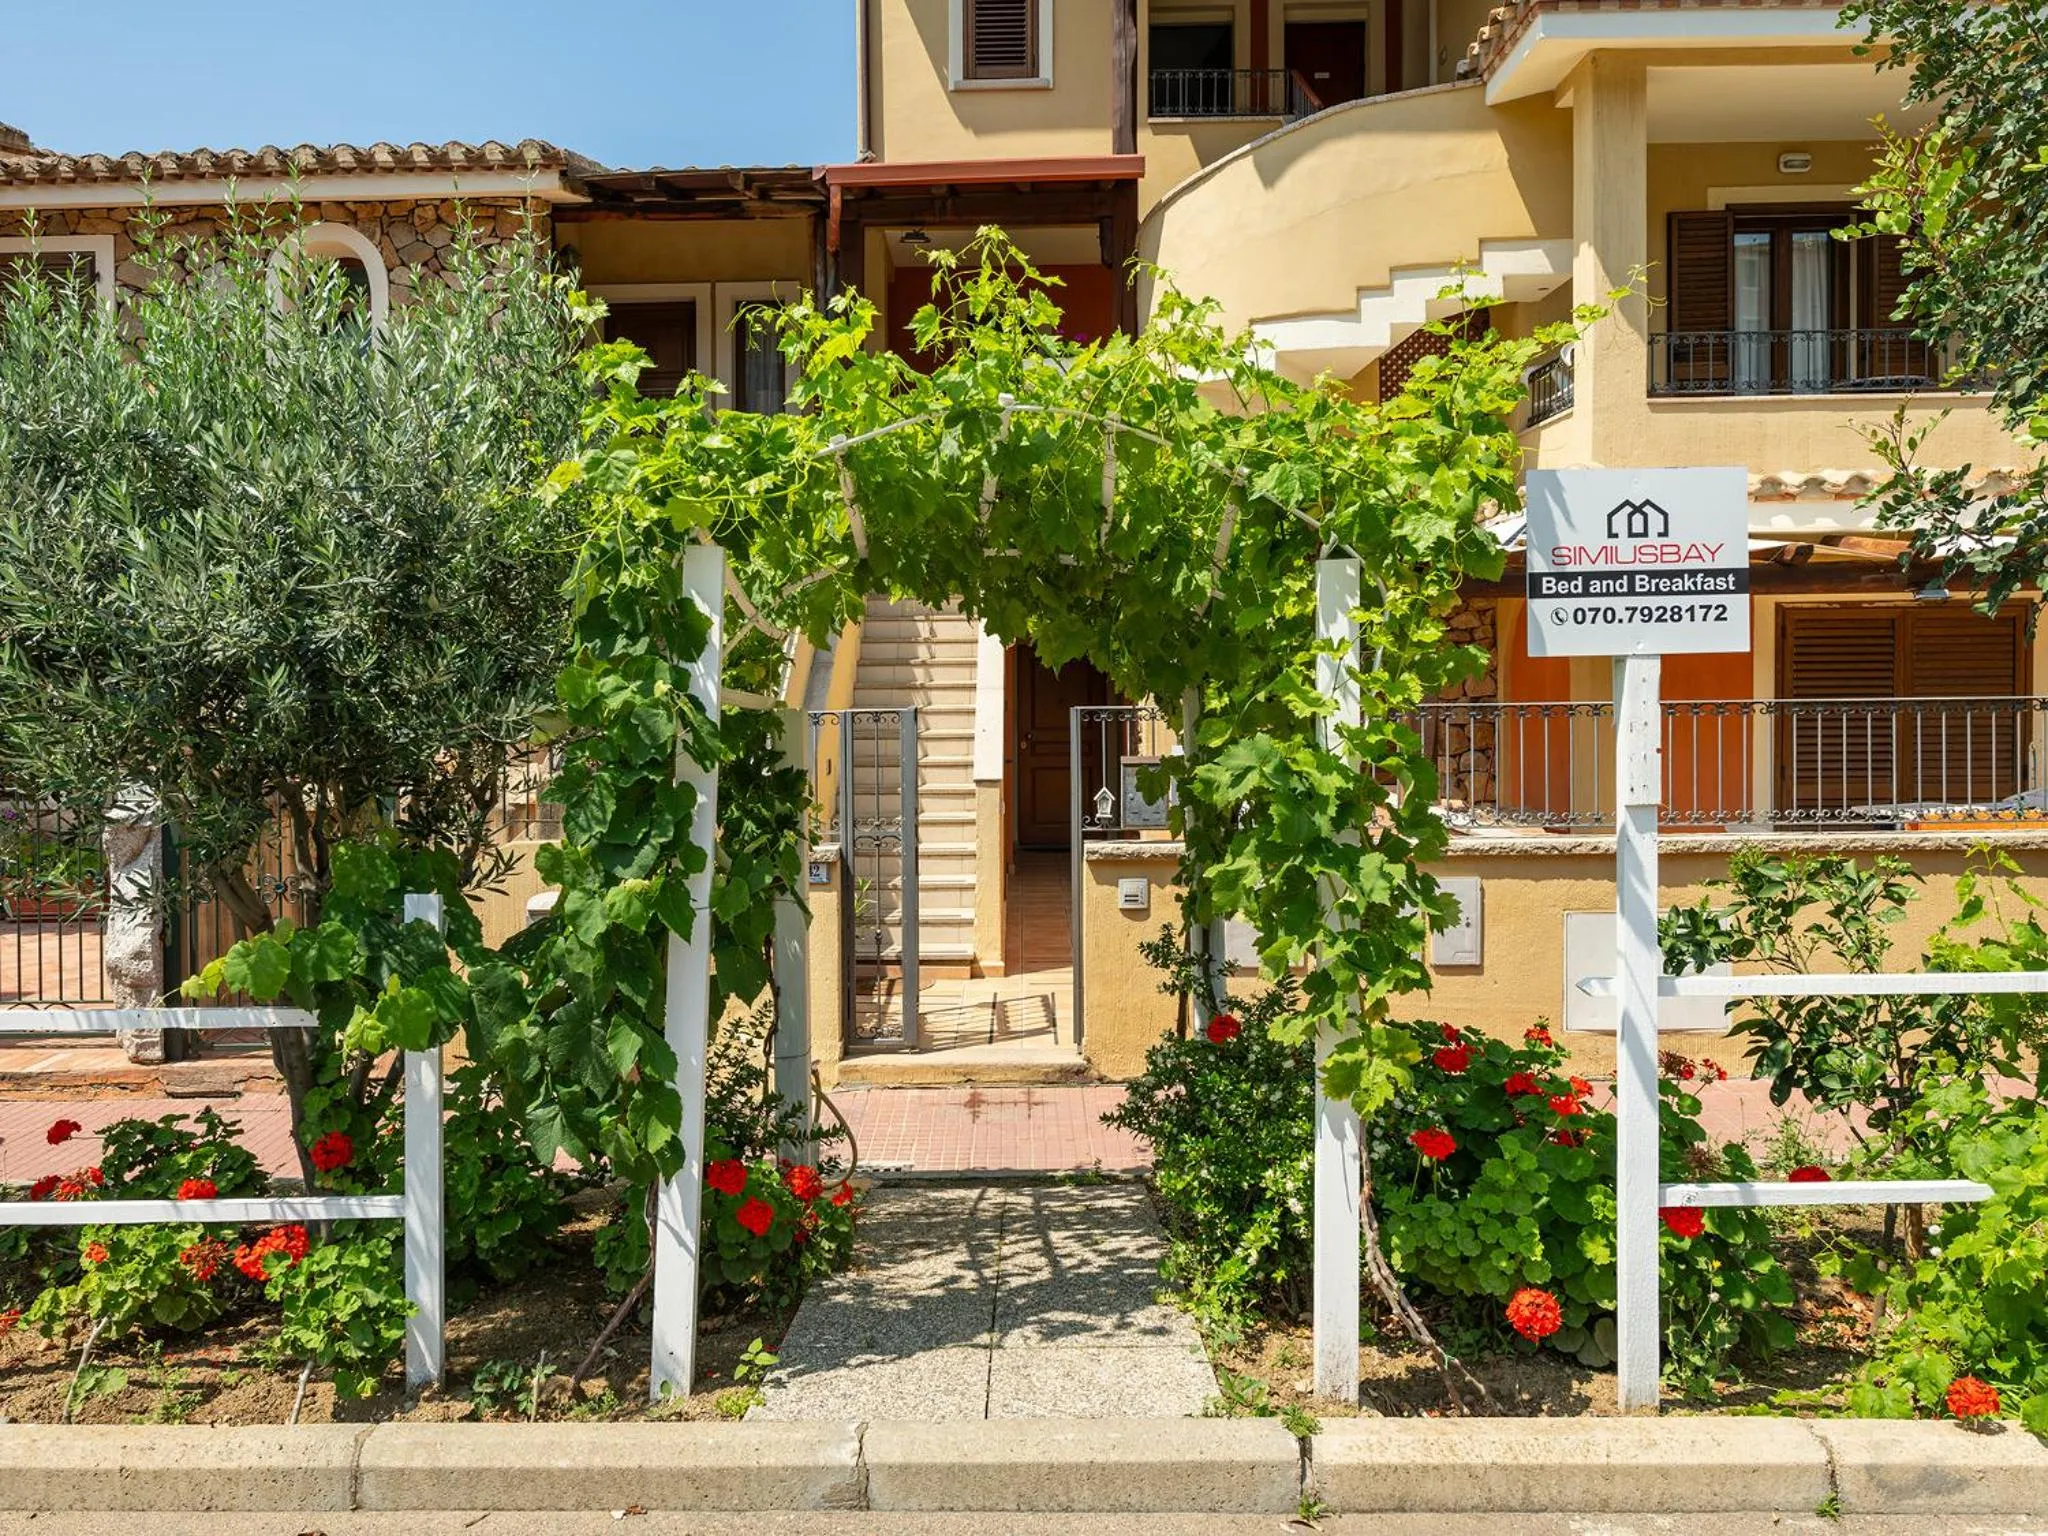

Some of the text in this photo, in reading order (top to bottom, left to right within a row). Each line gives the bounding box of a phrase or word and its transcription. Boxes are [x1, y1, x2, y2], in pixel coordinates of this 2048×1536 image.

[1551, 543, 1724, 566] SIMIUSBAY
[1541, 572, 1736, 595] Bed and Breakfast
[1573, 604, 1728, 625] 070.7928172
